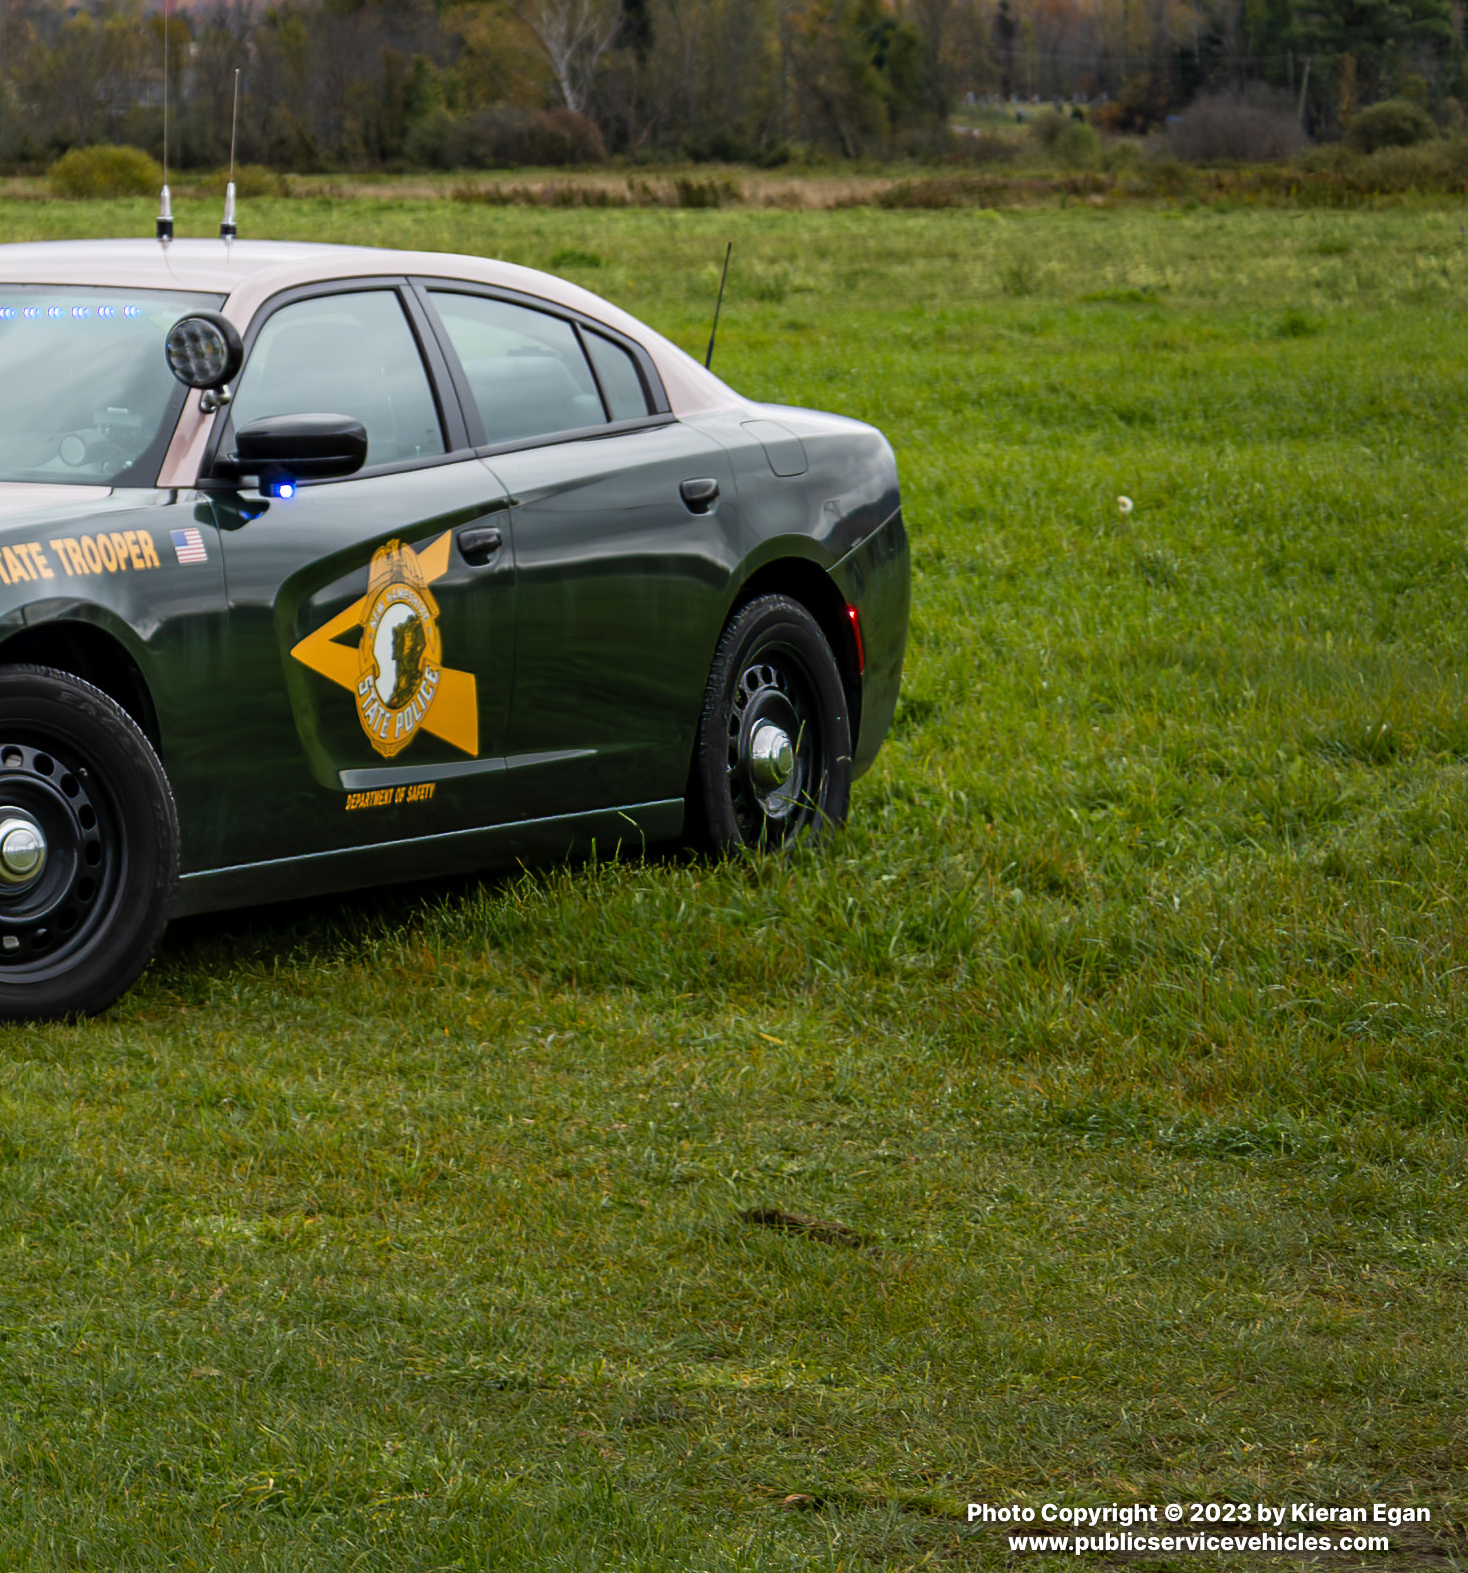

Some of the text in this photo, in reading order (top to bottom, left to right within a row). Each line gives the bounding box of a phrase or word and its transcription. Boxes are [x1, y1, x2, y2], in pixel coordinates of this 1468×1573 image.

[49, 530, 161, 577] TROOPER
[369, 588, 430, 629] NEW HAMPSHIRE
[358, 664, 440, 740] STATE POLICE
[345, 782, 436, 810] DEPARTMENT OF SAFETY
